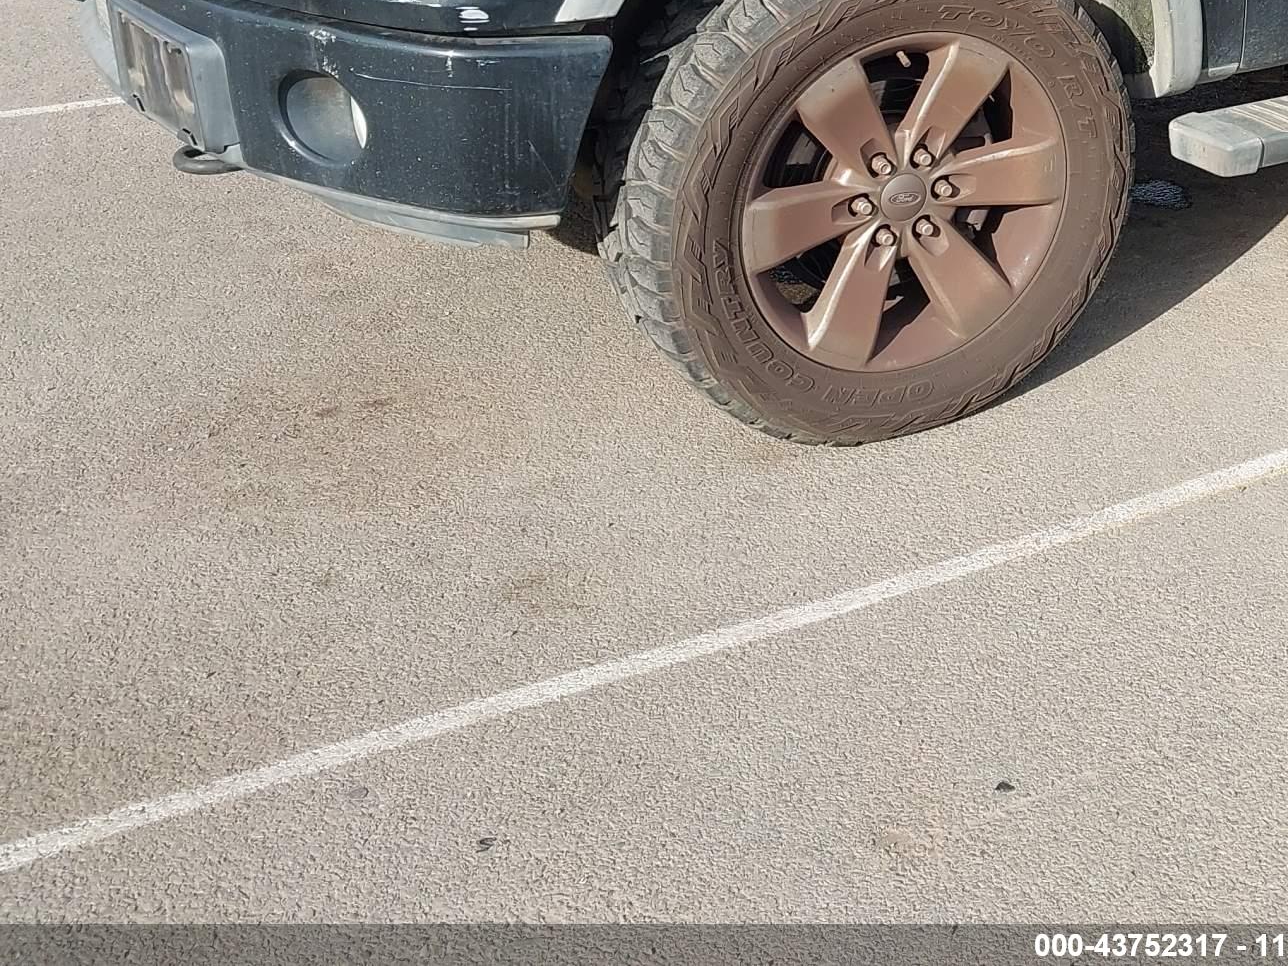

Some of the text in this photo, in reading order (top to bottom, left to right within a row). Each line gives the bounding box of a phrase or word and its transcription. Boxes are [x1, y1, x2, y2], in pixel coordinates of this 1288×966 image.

[937, 4, 1056, 60] TOYO
[1056, 74, 1098, 139] R/T
[712, 236, 935, 407] OPEN COUNTRY
